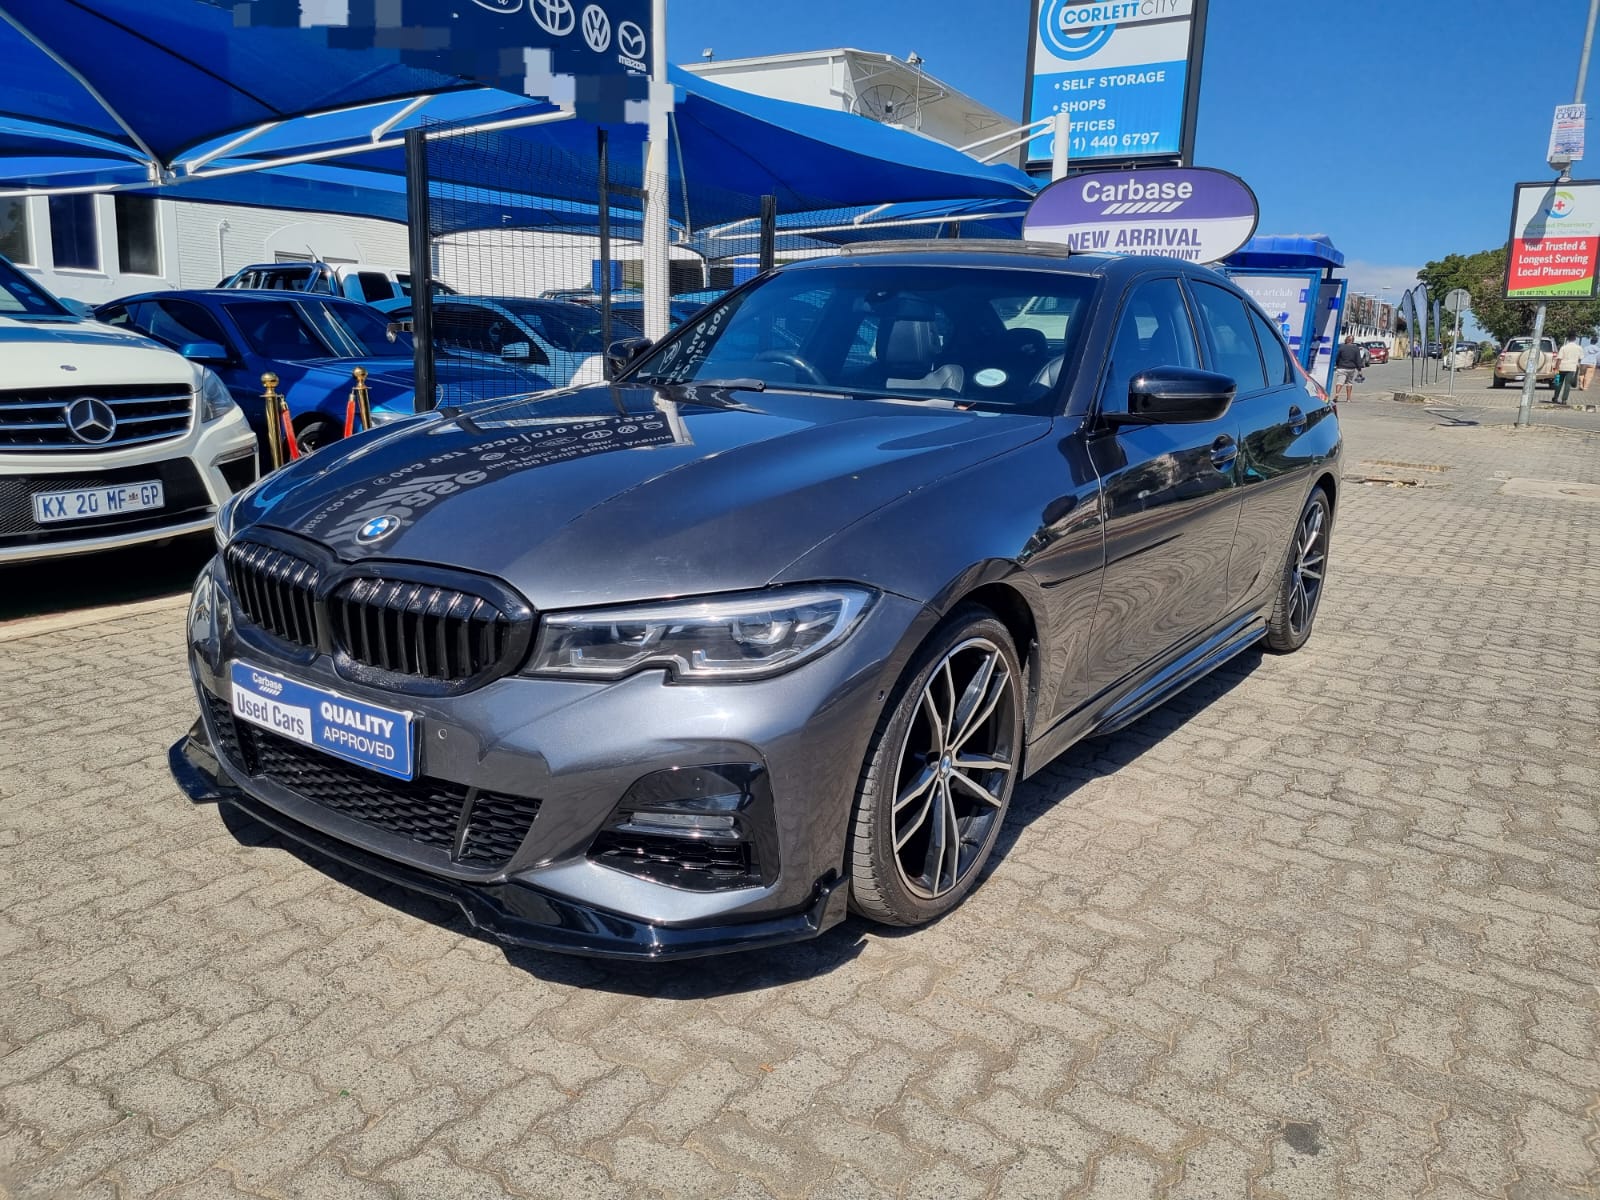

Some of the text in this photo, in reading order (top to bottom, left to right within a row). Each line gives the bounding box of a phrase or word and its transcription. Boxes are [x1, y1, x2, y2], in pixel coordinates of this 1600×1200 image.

[1062, 70, 1166, 91] SELF STORAGE
[1060, 99, 1106, 113] SHOPS
[1069, 119, 1116, 133] FFICES
[1090, 135, 1118, 148] 440
[1122, 132, 1160, 146] 6797
[1082, 179, 1193, 203] Carbase
[1067, 228, 1202, 250] NEW ARRIVAL
[1524, 241, 1587, 252] Your Trusted &
[1519, 253, 1589, 266] Longest Serving
[1518, 266, 1586, 277] Local Pharmacy
[42, 485, 159, 518] KX 20 MF GP
[252, 672, 283, 690] Carbase
[236, 691, 305, 735] Used Cars
[320, 701, 394, 739] QUALITY
[323, 725, 395, 760] APPROVED
